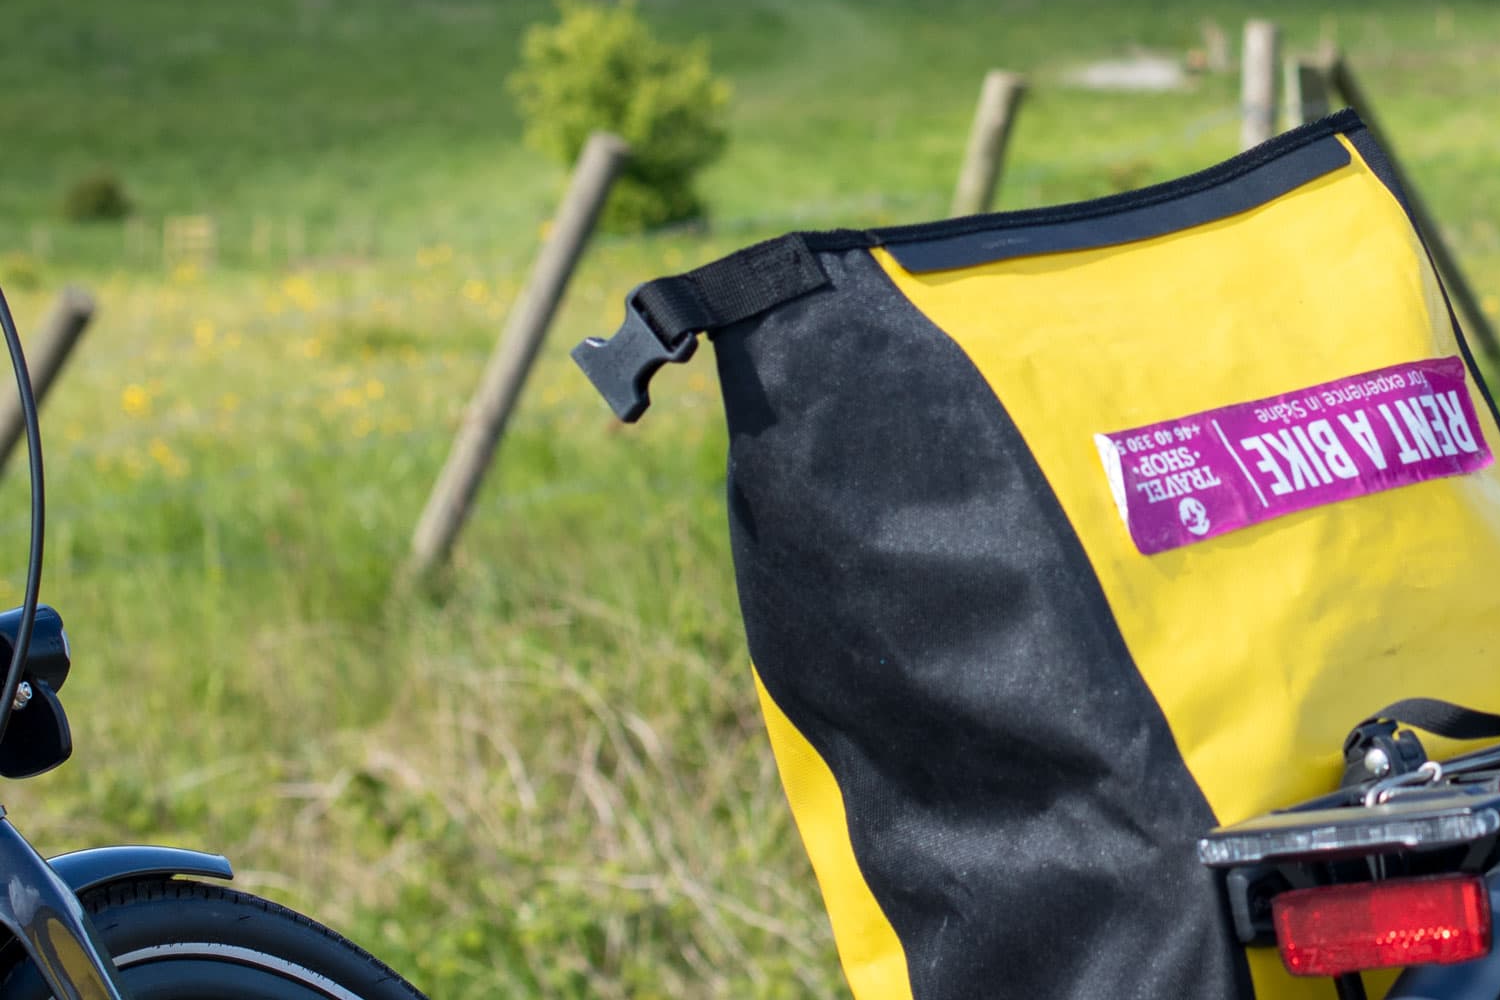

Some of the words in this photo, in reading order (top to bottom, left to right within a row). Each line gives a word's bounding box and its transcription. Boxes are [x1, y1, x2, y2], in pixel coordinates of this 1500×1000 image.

[1324, 373, 1406, 407] experience
[1408, 369, 1428, 389] for
[1257, 401, 1305, 425] Skåne
[1304, 393, 1323, 413] in
[1154, 430, 1175, 447] 40
[1177, 424, 1201, 442] +46
[1338, 408, 1388, 470] A
[1378, 390, 1478, 464] RENT
[1126, 436, 1152, 453] 330
[1240, 418, 1360, 496] BIKE
[1136, 465, 1221, 504] TRAVEL
